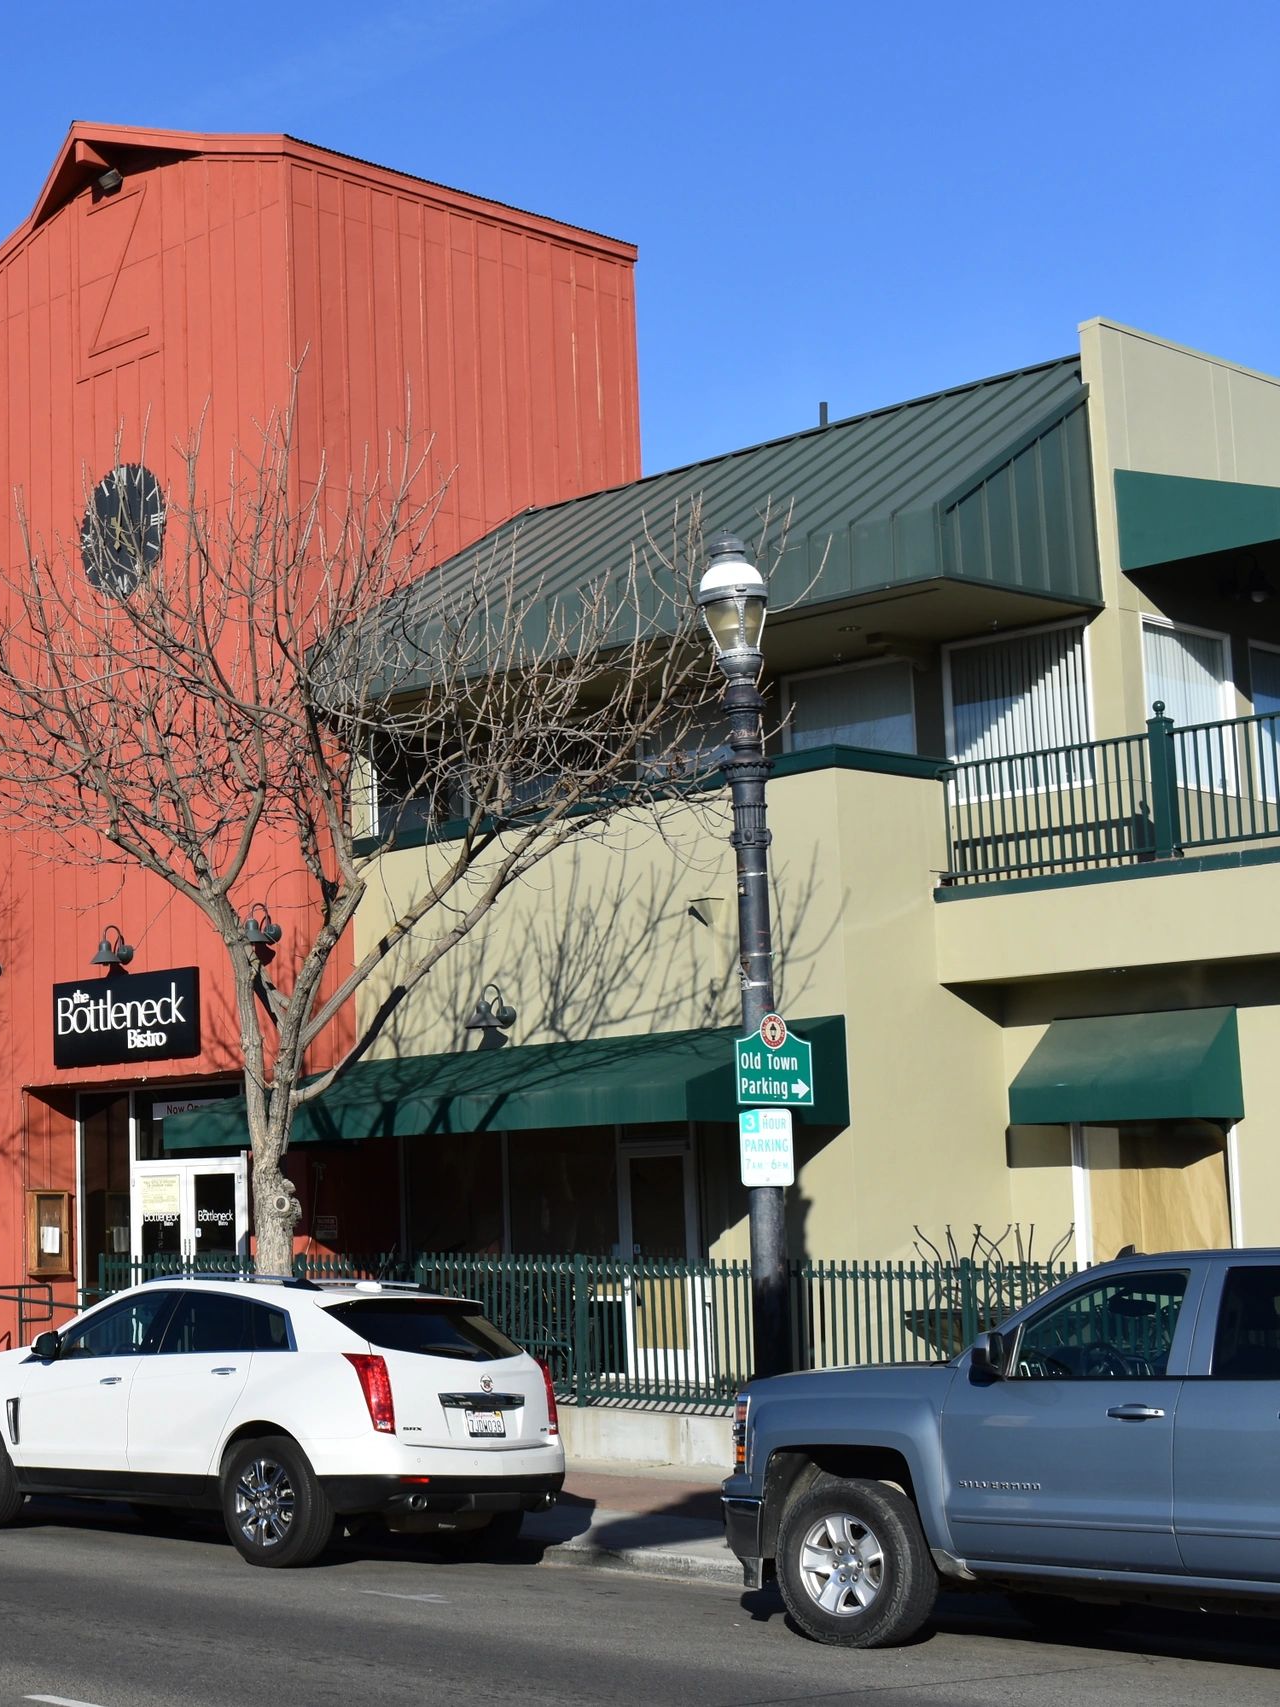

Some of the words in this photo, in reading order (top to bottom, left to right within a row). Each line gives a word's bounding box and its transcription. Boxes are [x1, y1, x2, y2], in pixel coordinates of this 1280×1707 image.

[73, 990, 89, 1004] the
[57, 981, 186, 1035] Bottleneck
[127, 1029, 167, 1049] Bistro
[741, 1052, 761, 1070] Old
[767, 1054, 798, 1071] Town
[742, 1077, 788, 1100] Parking
[166, 1103, 185, 1115] Now
[745, 1114, 756, 1130] 3
[762, 1118, 786, 1130] HOUR
[744, 1138, 789, 1153] PARKING
[198, 1209, 234, 1222] Bottleneck
